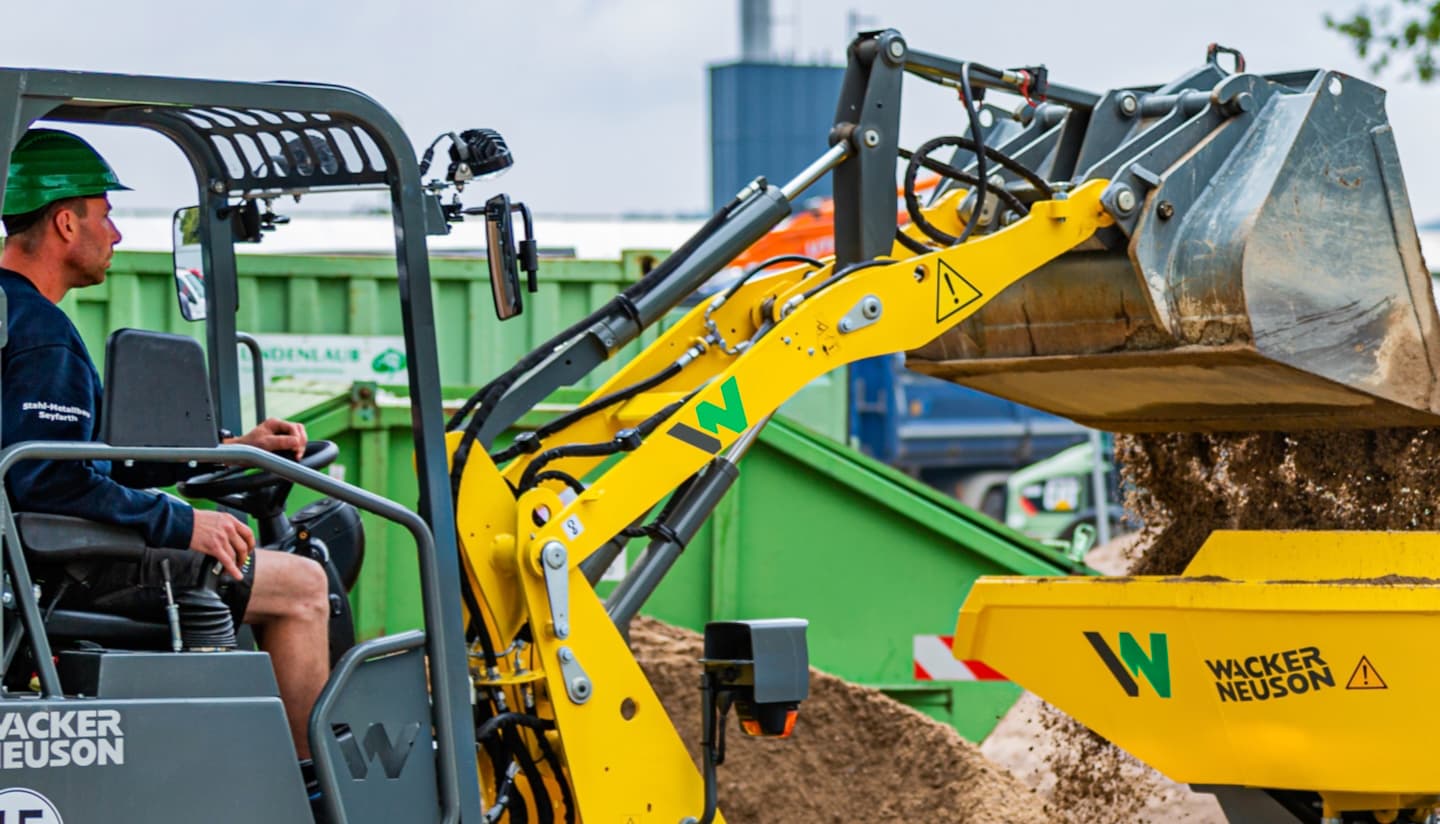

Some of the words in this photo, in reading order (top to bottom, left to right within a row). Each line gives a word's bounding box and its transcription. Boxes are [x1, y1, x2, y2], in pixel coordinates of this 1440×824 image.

[1205, 646, 1328, 681] WACKER
[1215, 666, 1336, 702] NEUSON
[0, 737, 125, 769] EUSON
